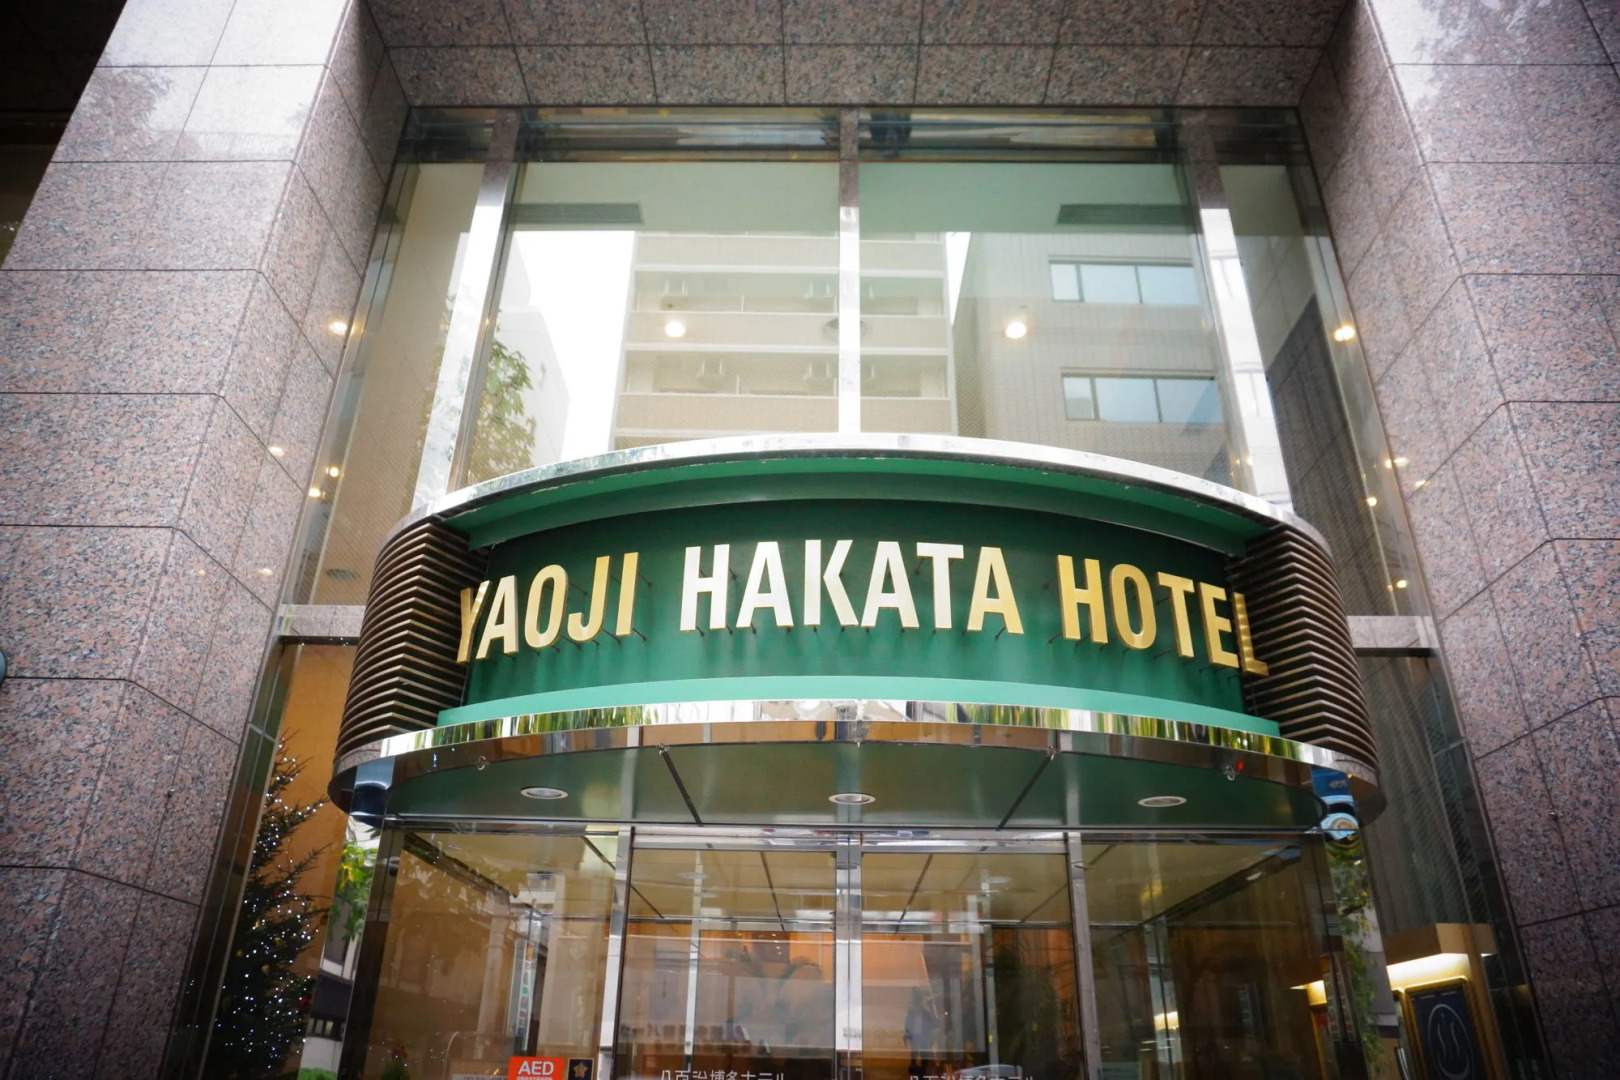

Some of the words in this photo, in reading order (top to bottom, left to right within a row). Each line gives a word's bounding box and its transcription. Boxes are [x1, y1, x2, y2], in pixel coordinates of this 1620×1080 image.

[456, 551, 639, 663] YAOJI
[679, 539, 1024, 634] HAKATA
[1056, 554, 1269, 676] HOTEL
[518, 1061, 554, 1075] AED
